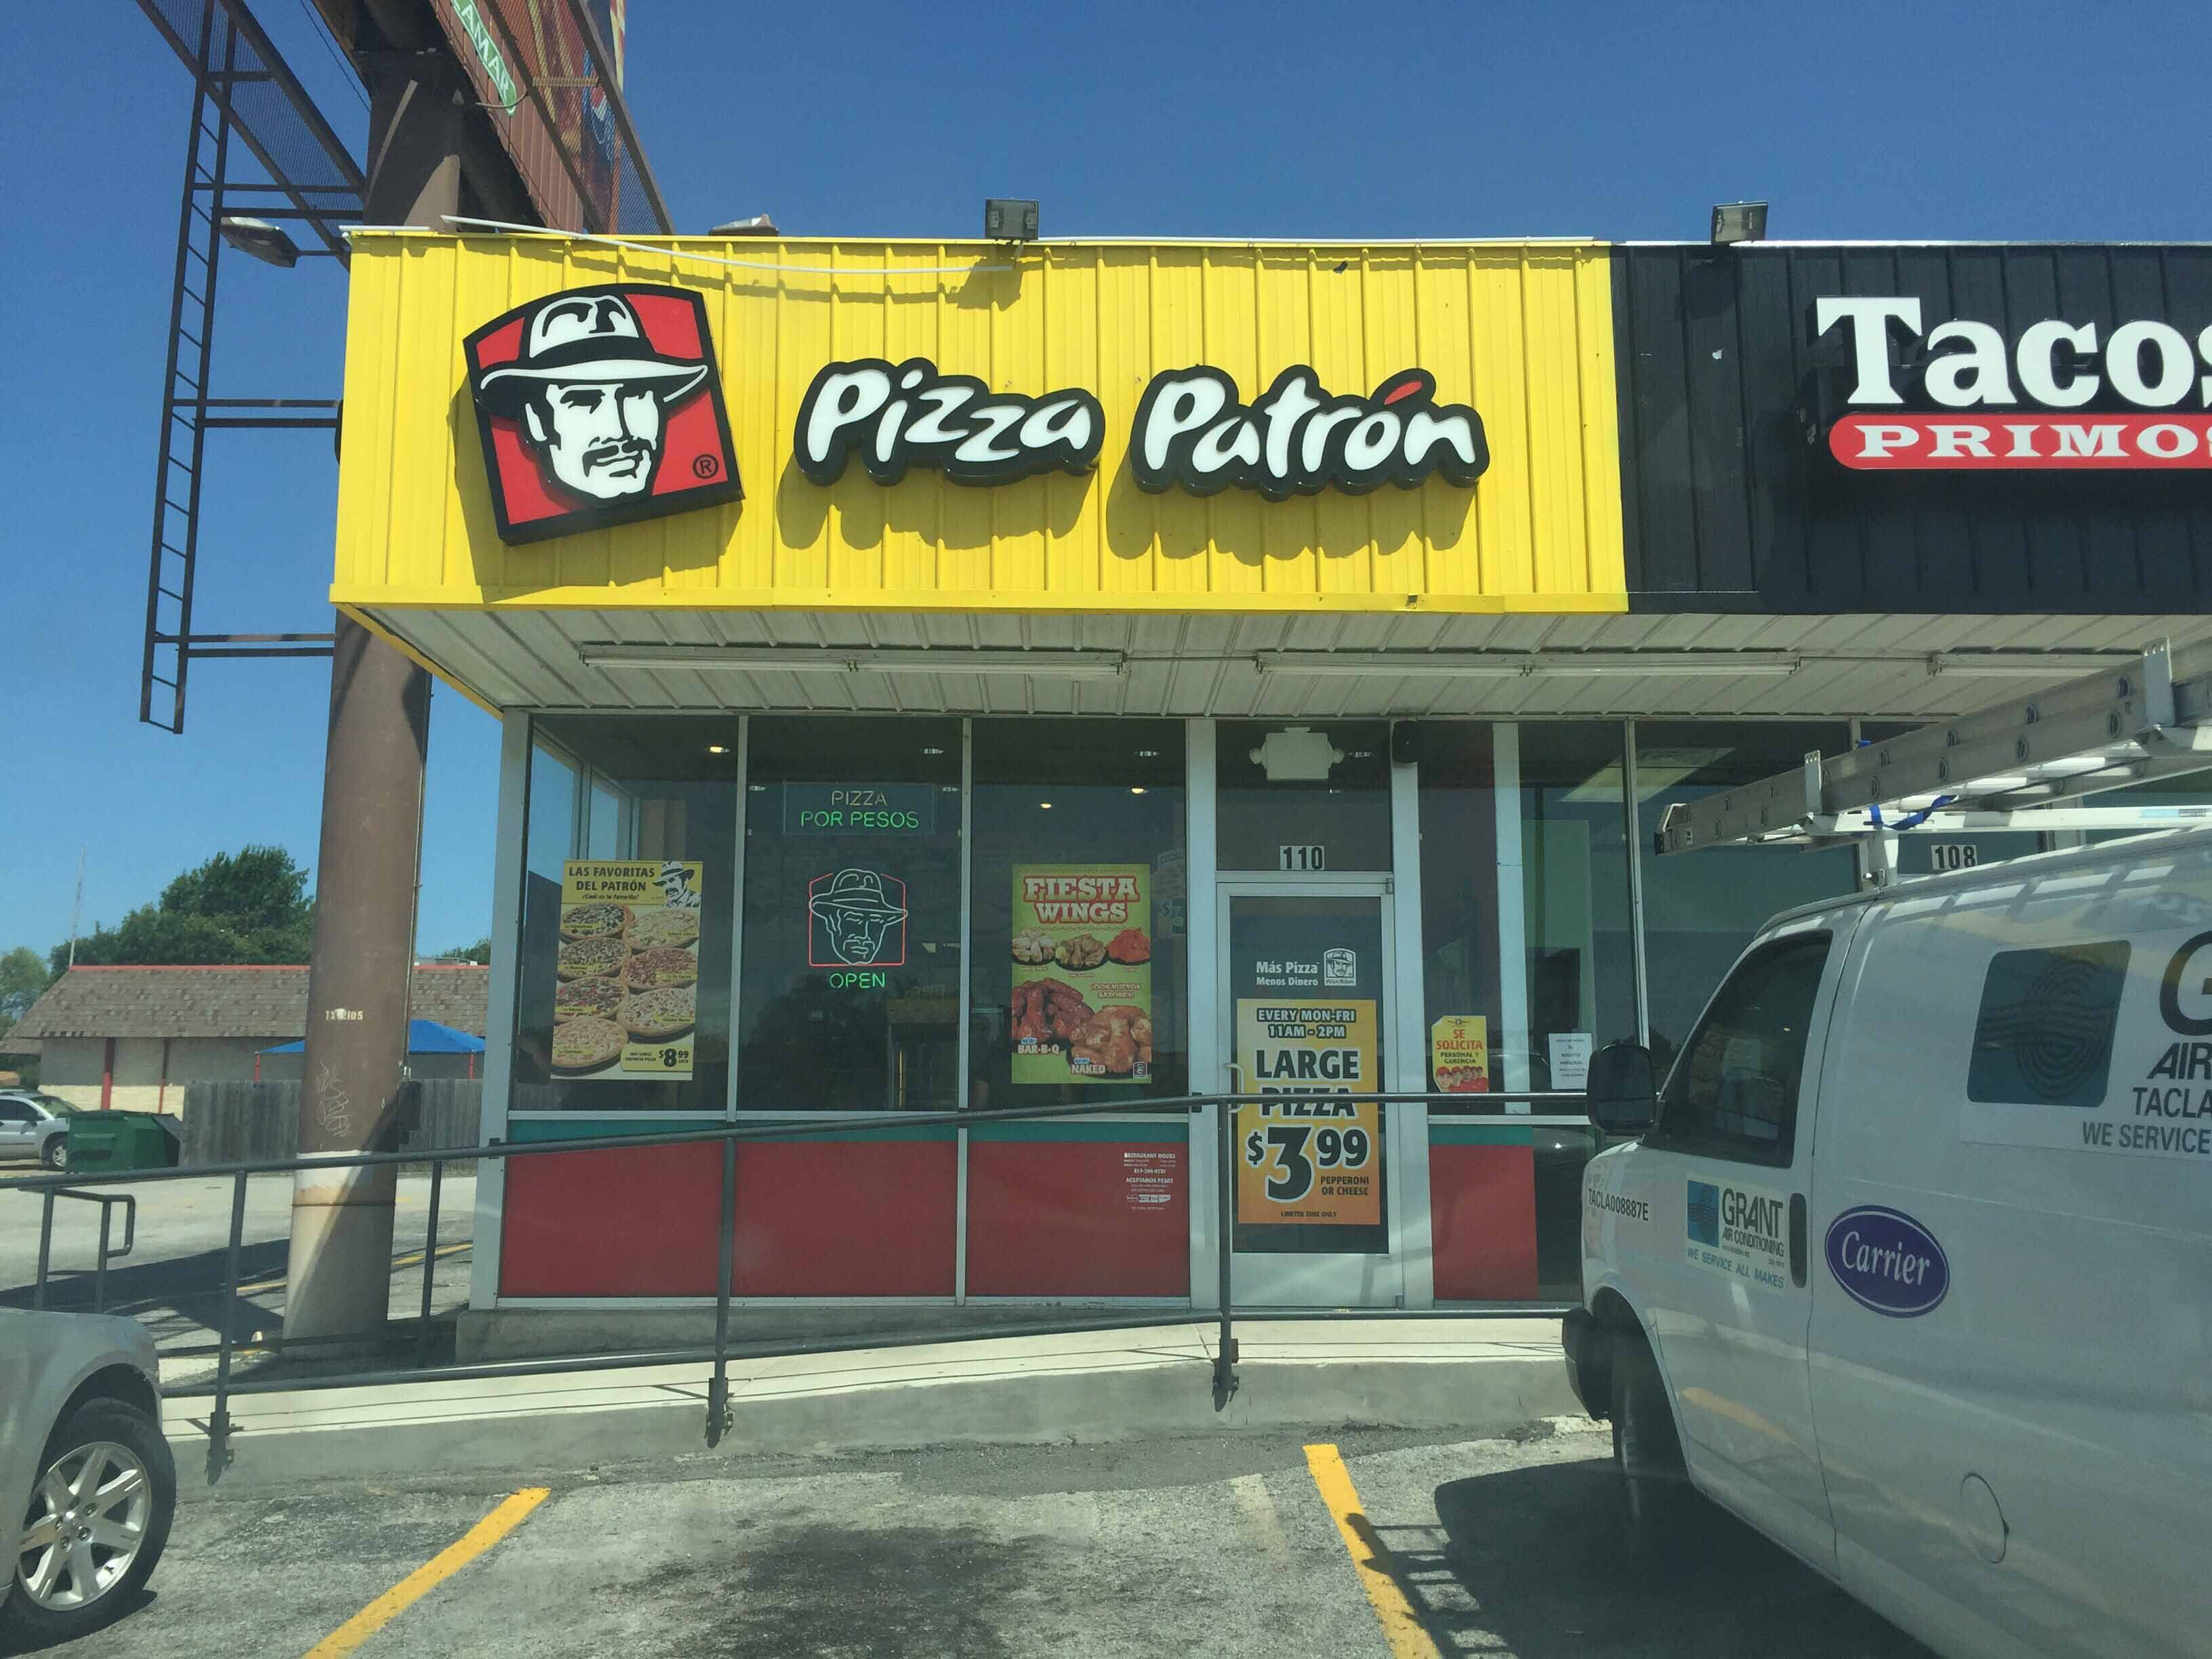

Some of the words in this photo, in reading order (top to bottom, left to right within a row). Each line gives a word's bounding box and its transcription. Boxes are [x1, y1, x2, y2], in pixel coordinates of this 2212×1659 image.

[1816, 296, 2212, 408] Taco
[805, 366, 1094, 465] Pizza
[1142, 374, 1478, 480] Patrón
[1853, 424, 2212, 458] PRIMO
[831, 790, 888, 806] PIZZA
[800, 811, 844, 827] POR
[850, 811, 920, 829] PESOS
[1282, 846, 1324, 870] 110
[1934, 845, 1975, 869] 108
[569, 866, 590, 878] LAS
[593, 867, 656, 878] FAVORITAS
[575, 880, 597, 891] DEL
[601, 879, 647, 892] PATRÓN
[1024, 877, 1140, 901] FIESTA
[1036, 902, 1127, 922] WINGS
[1256, 960, 1282, 974] Más
[1285, 961, 1319, 974] Pizza
[829, 972, 886, 989] OPEN
[1256, 977, 1286, 985] Menos
[1288, 977, 1319, 986] Dinero
[1257, 1009, 1297, 1021] EVERY
[1300, 1010, 1356, 1022] MON-FRI
[1269, 1025, 1305, 1038] 11AM
[1317, 1025, 1346, 1038] 2PM
[1453, 1029, 1465, 1039] SE
[1436, 1040, 1483, 1050] SOLICITA
[1071, 1064, 1106, 1074] NAKED
[1256, 1049, 1359, 1080] LARGE
[1262, 1086, 1355, 1117] PIZZA
[2083, 1121, 2114, 1147] WE
[2118, 1124, 2212, 1154] SERVICE
[1320, 1176, 1370, 1185] PEPPERONI
[1322, 1187, 1334, 1195] OR
[1336, 1187, 1370, 1195] CHEESE
[1589, 1188, 1649, 1221] TACLA008887E
[1722, 1188, 1784, 1239] GRANT
[1723, 1227, 1733, 1242] AIR
[1734, 1230, 1784, 1257] CONDITIONING
[1686, 1246, 1700, 1260] WE
[1702, 1251, 1734, 1272] SERVICE
[1736, 1263, 1750, 1277] ALL
[1754, 1268, 1784, 1289] MAKES
[1841, 1230, 1931, 1286] Carrier
